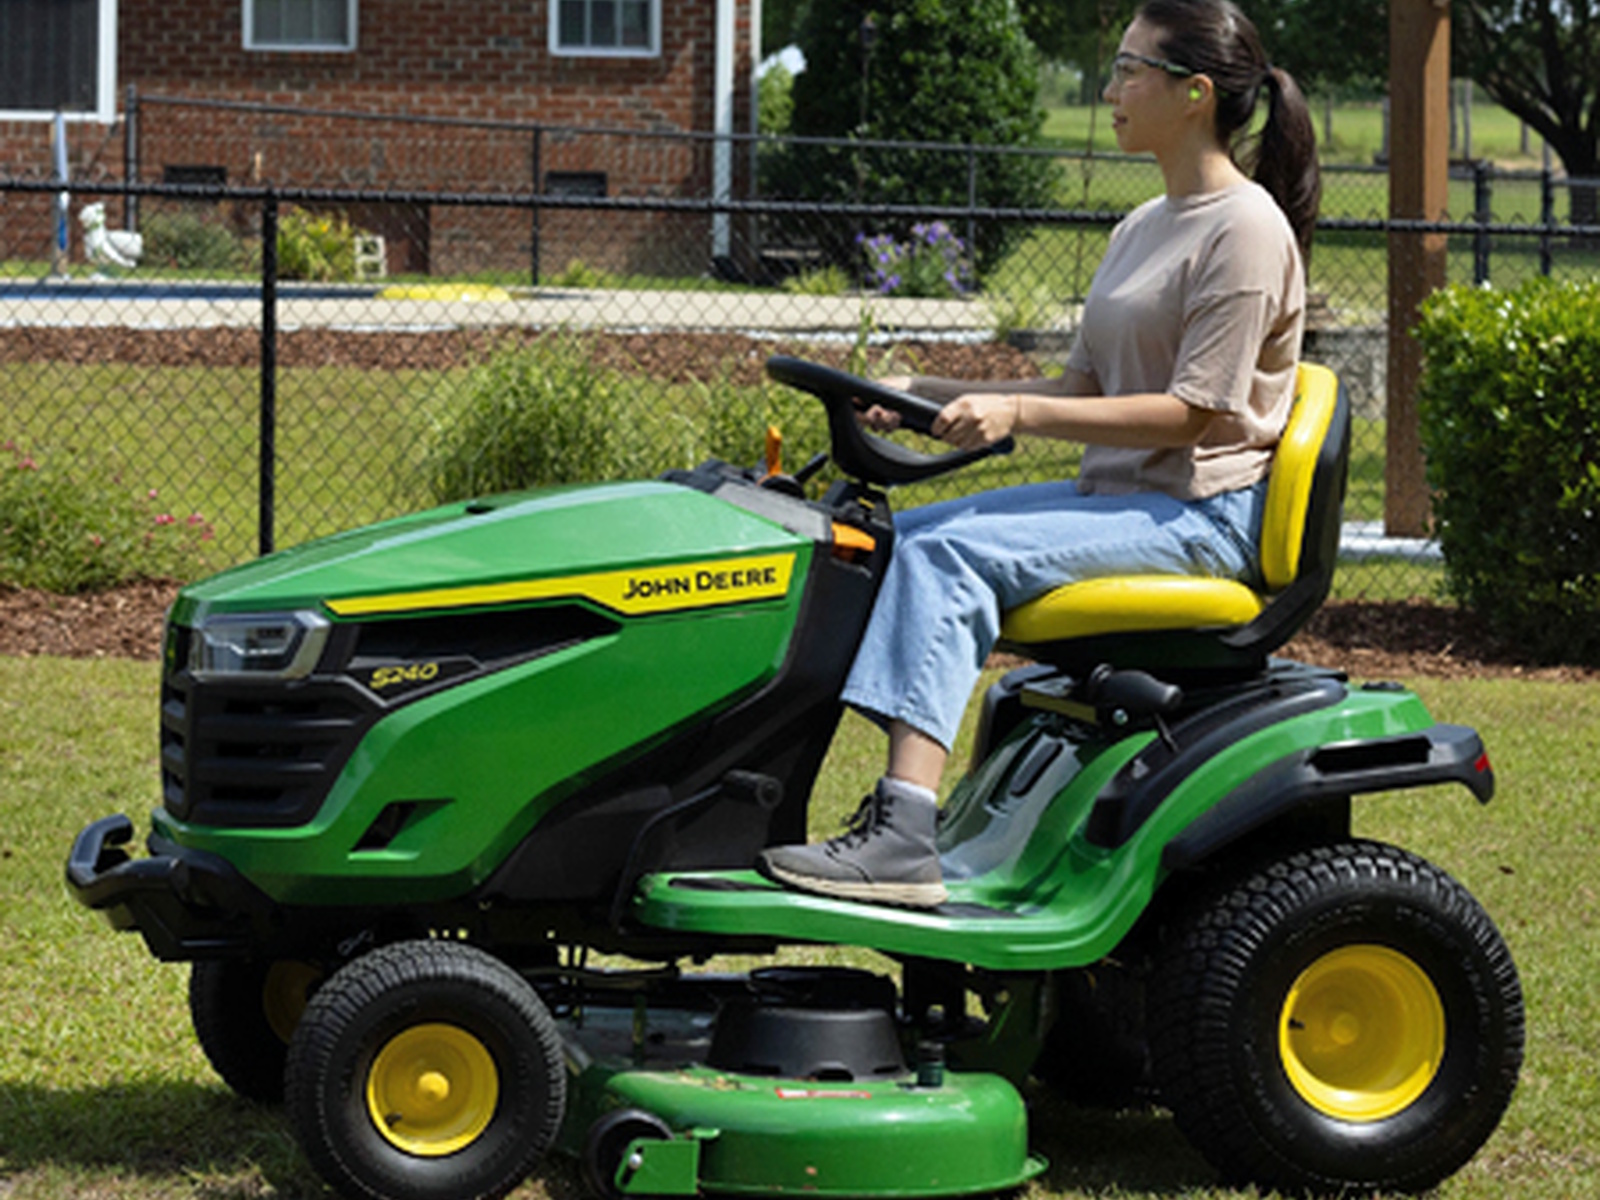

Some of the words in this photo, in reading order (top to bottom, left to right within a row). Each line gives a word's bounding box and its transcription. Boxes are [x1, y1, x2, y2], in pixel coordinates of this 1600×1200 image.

[623, 577, 691, 600] JOHN
[696, 567, 777, 591] DEERE
[369, 661, 439, 690] S240
